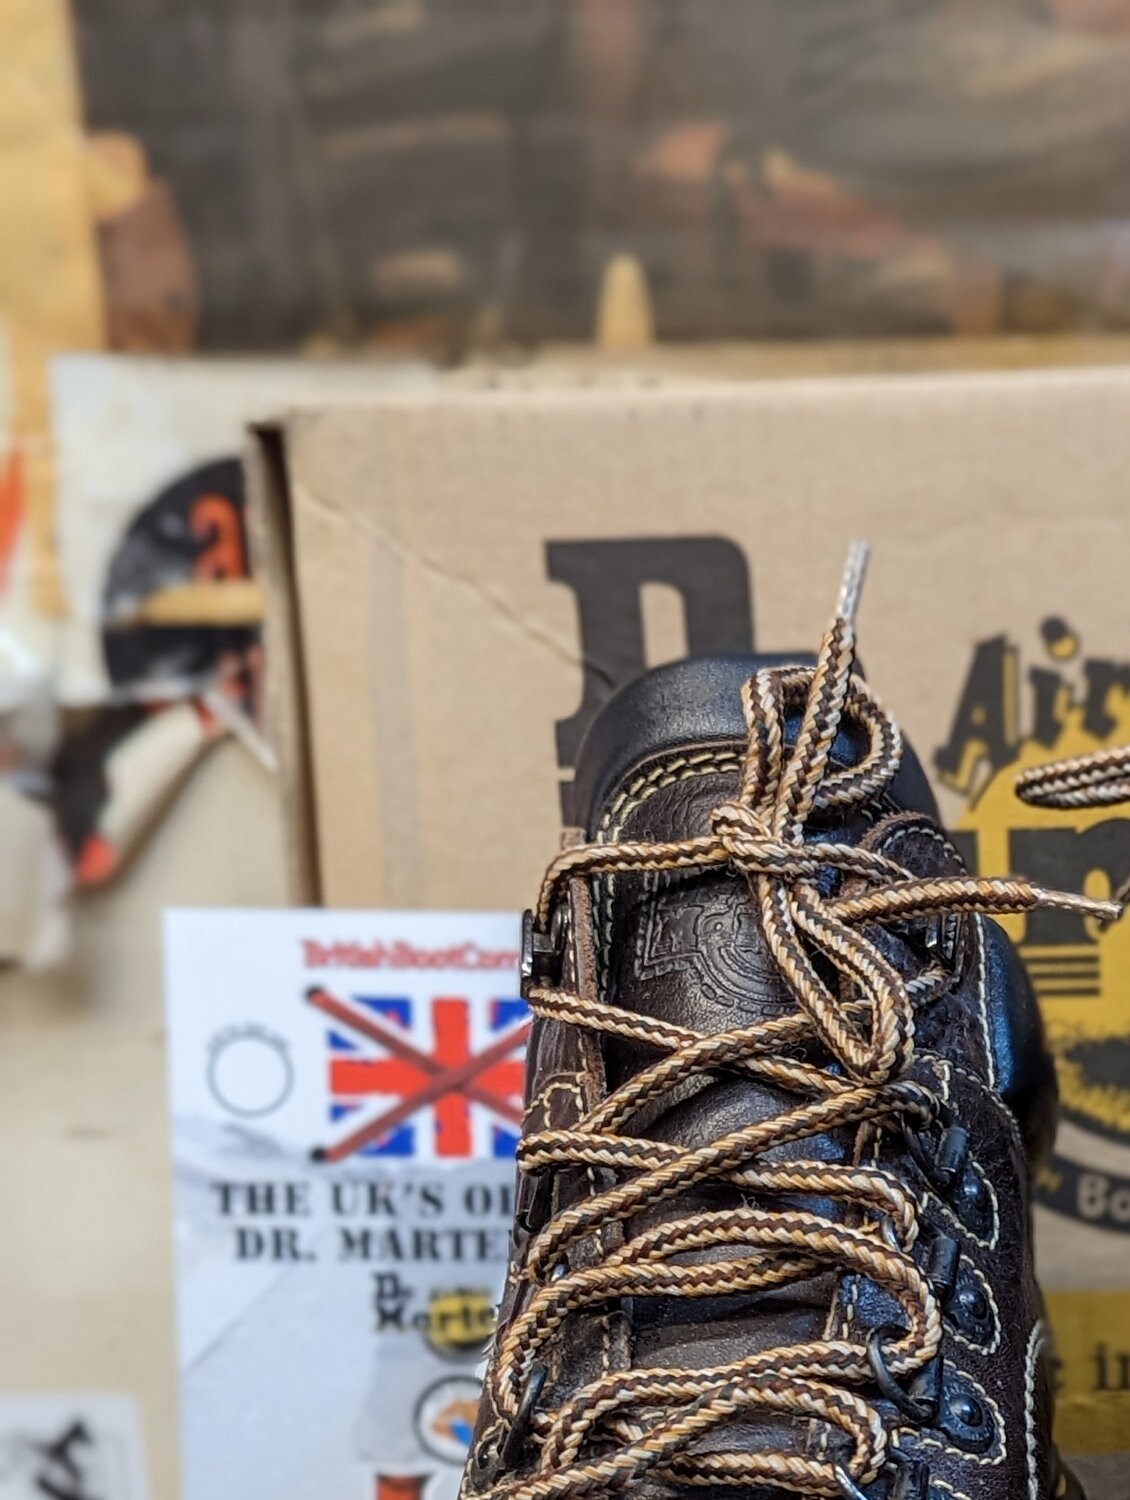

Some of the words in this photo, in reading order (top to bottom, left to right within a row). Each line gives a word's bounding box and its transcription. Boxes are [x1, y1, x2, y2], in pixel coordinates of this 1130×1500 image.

[211, 1180, 312, 1219] THE
[331, 1181, 444, 1217] UK'S
[234, 1226, 315, 1262] DR.
[338, 1226, 511, 1262] MARTE
